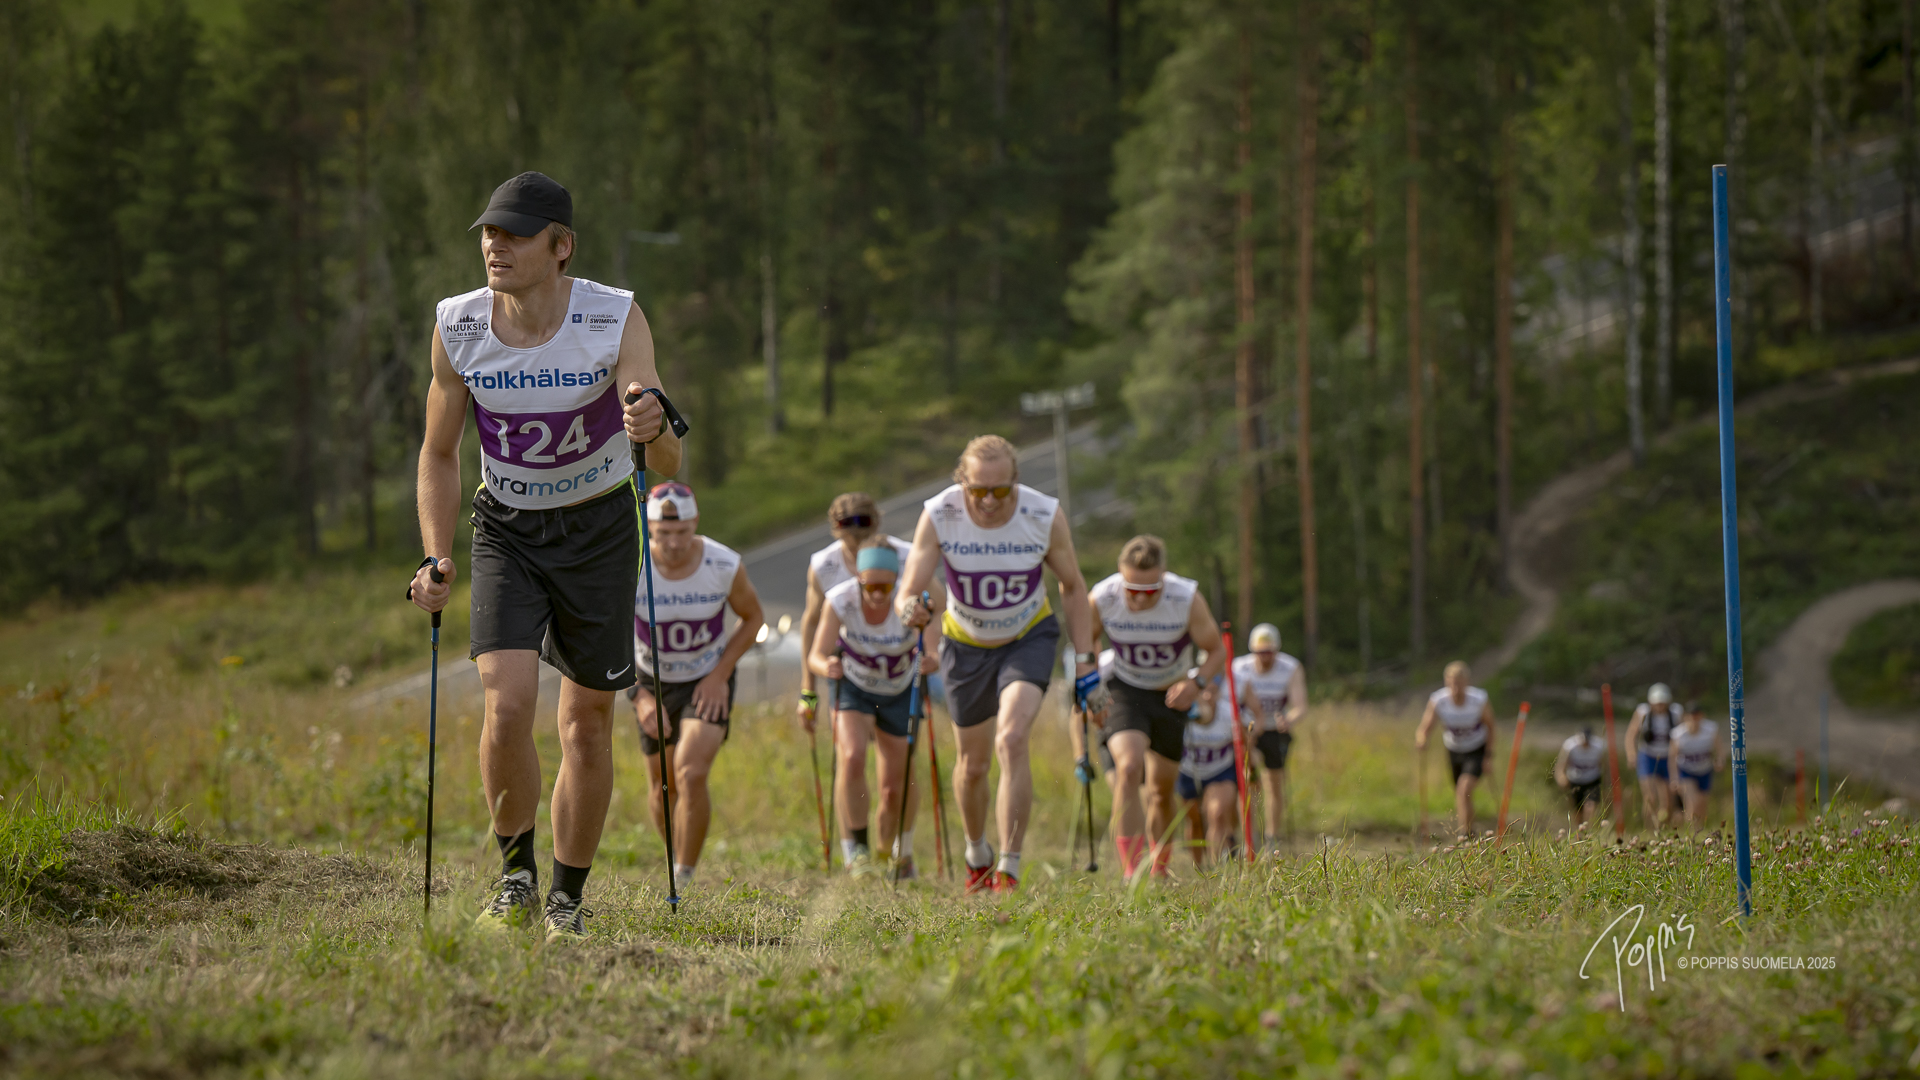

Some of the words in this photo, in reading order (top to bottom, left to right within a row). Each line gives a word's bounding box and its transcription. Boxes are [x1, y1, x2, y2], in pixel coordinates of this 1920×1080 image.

[446, 322, 489, 333] NUUKSIO
[472, 368, 608, 390] folkhälsan
[492, 414, 591, 464] 124
[957, 574, 1029, 609] 105
[655, 621, 713, 652] 104
[1121, 644, 1177, 668] 103
